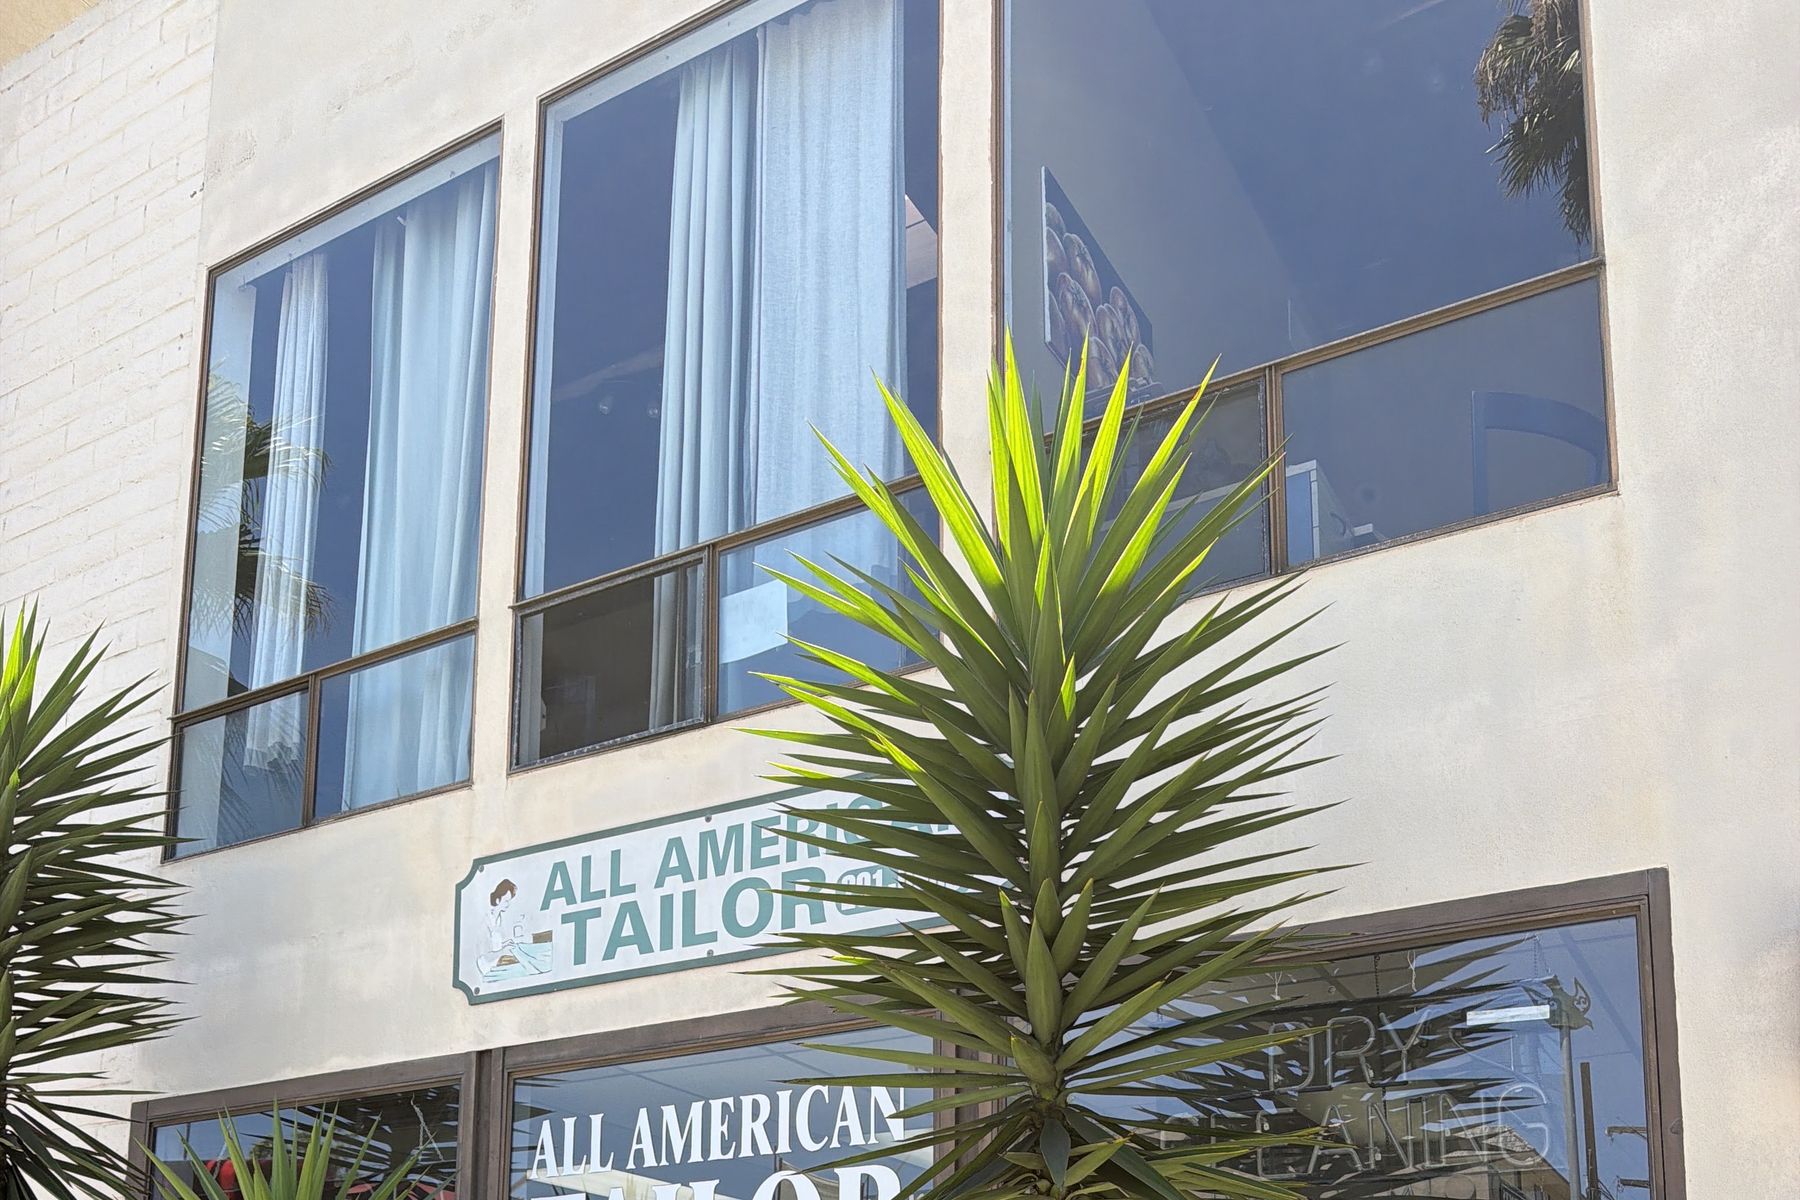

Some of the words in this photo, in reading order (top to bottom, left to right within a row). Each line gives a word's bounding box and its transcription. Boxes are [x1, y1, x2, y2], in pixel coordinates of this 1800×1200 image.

[540, 849, 637, 912] ALL
[654, 795, 955, 889] AMERIC
[561, 866, 828, 966] TAILOR
[530, 1112, 614, 1180] ALL
[626, 1084, 905, 1170] AMERICAN
